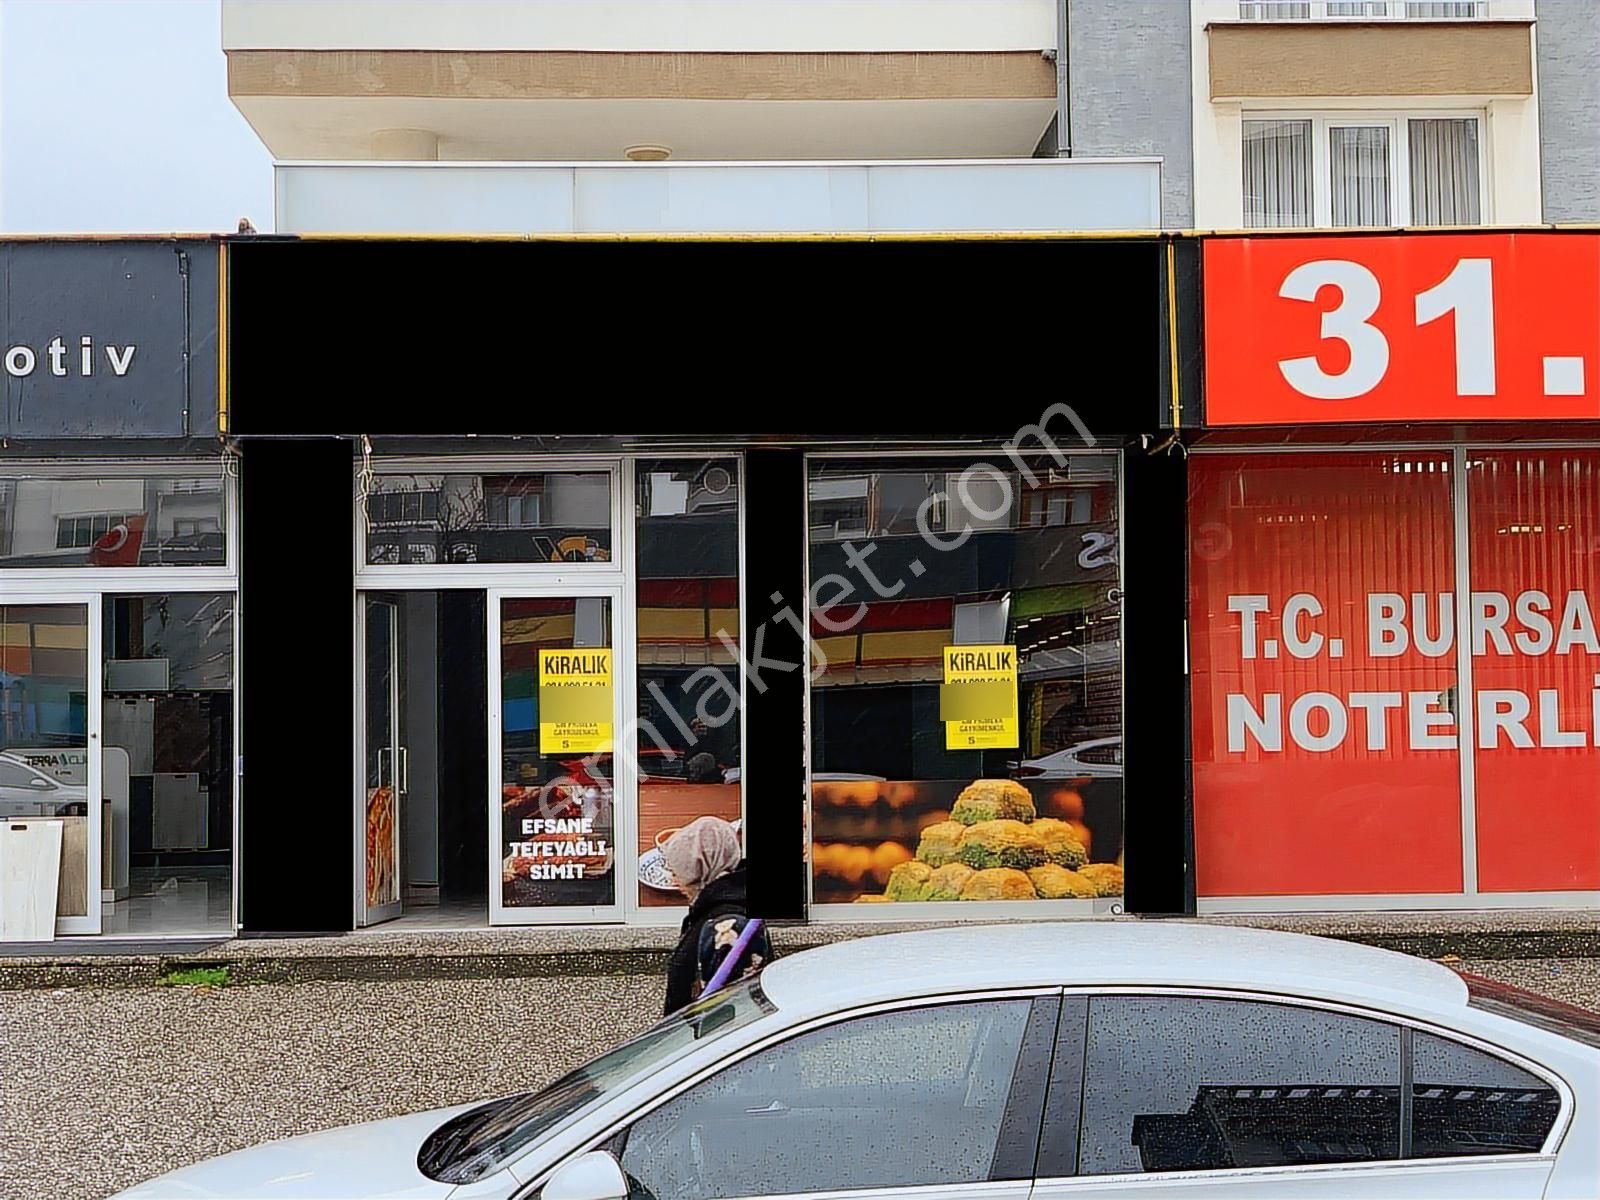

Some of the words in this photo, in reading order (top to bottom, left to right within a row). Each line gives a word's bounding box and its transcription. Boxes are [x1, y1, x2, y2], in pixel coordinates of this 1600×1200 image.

[4, 335, 137, 377] otiv
[1277, 257, 1586, 400] 31.
[1227, 592, 1344, 660] T.C.
[1367, 590, 1600, 658] BURSA
[521, 818, 593, 835] EFSANE
